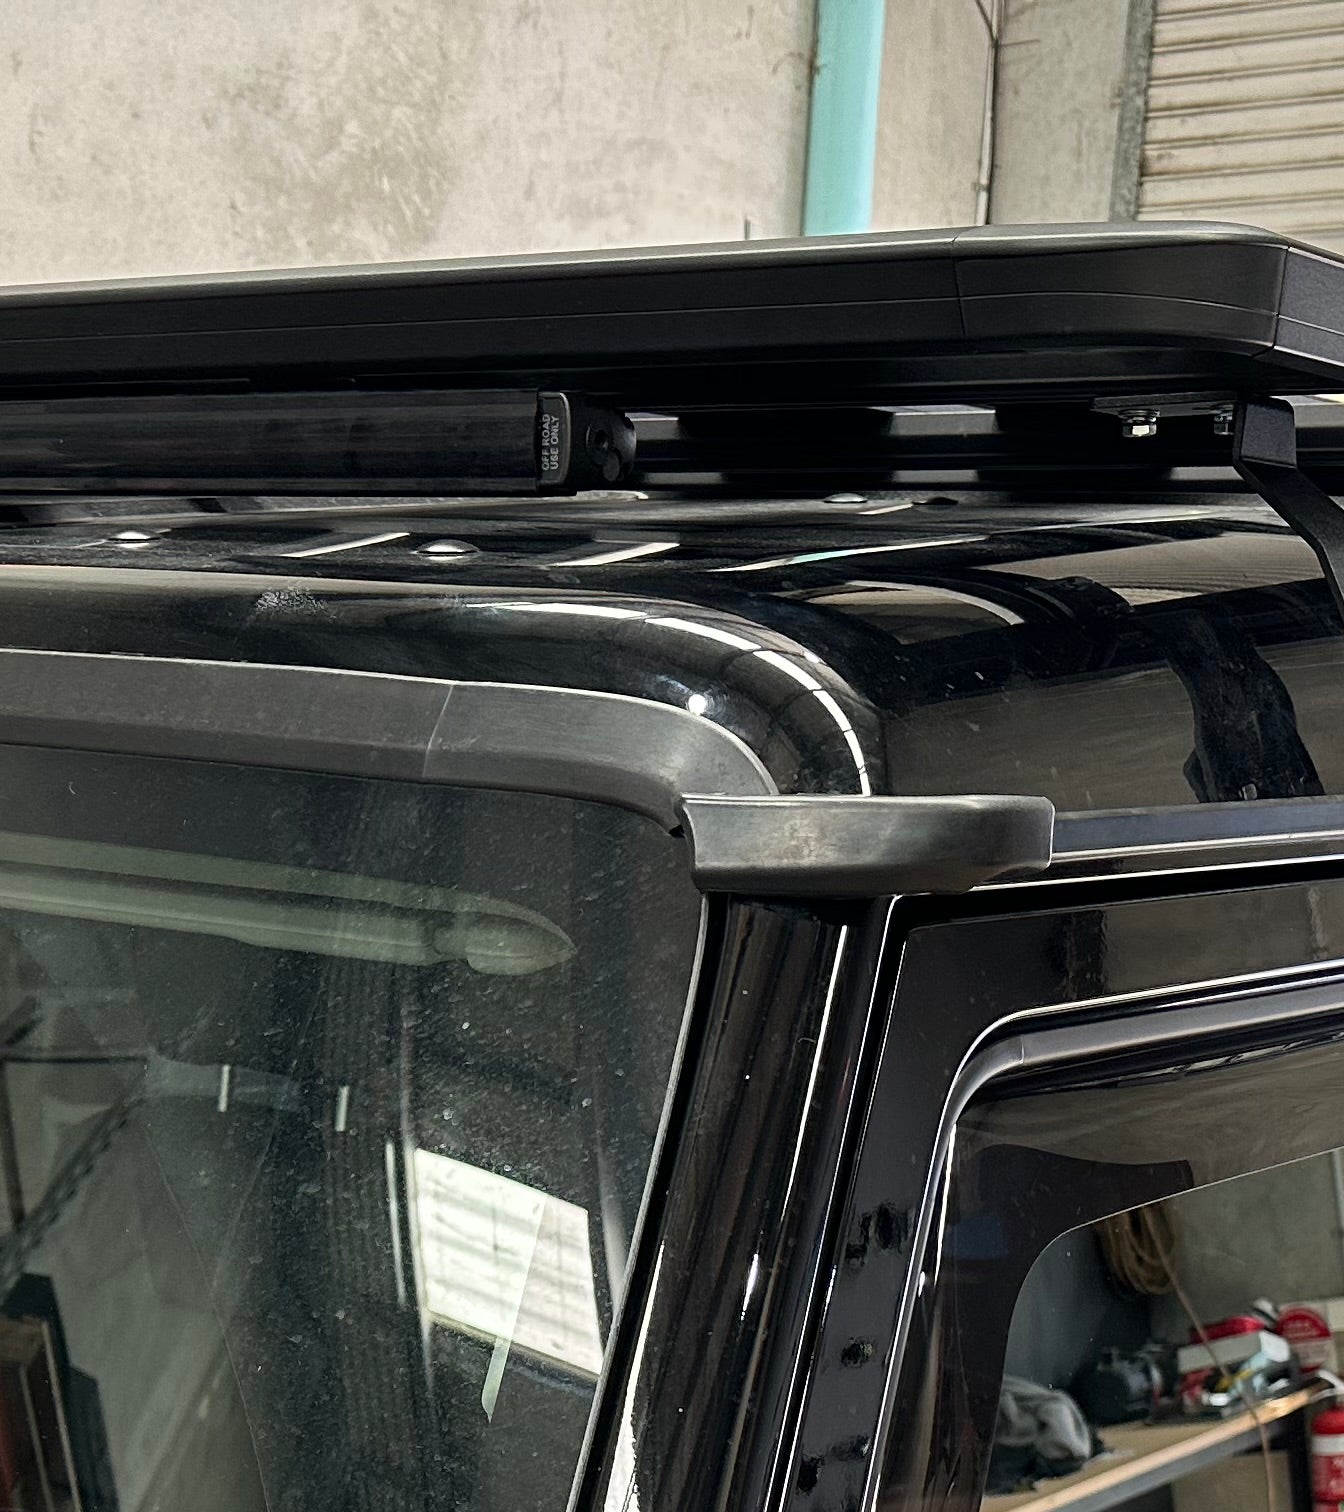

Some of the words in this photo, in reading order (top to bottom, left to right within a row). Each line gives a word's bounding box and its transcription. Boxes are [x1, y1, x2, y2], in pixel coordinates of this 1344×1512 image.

[541, 413, 551, 446] ROAD
[550, 415, 560, 445] ONLY
[541, 447, 550, 471] OFF
[550, 447, 559, 470] USE
